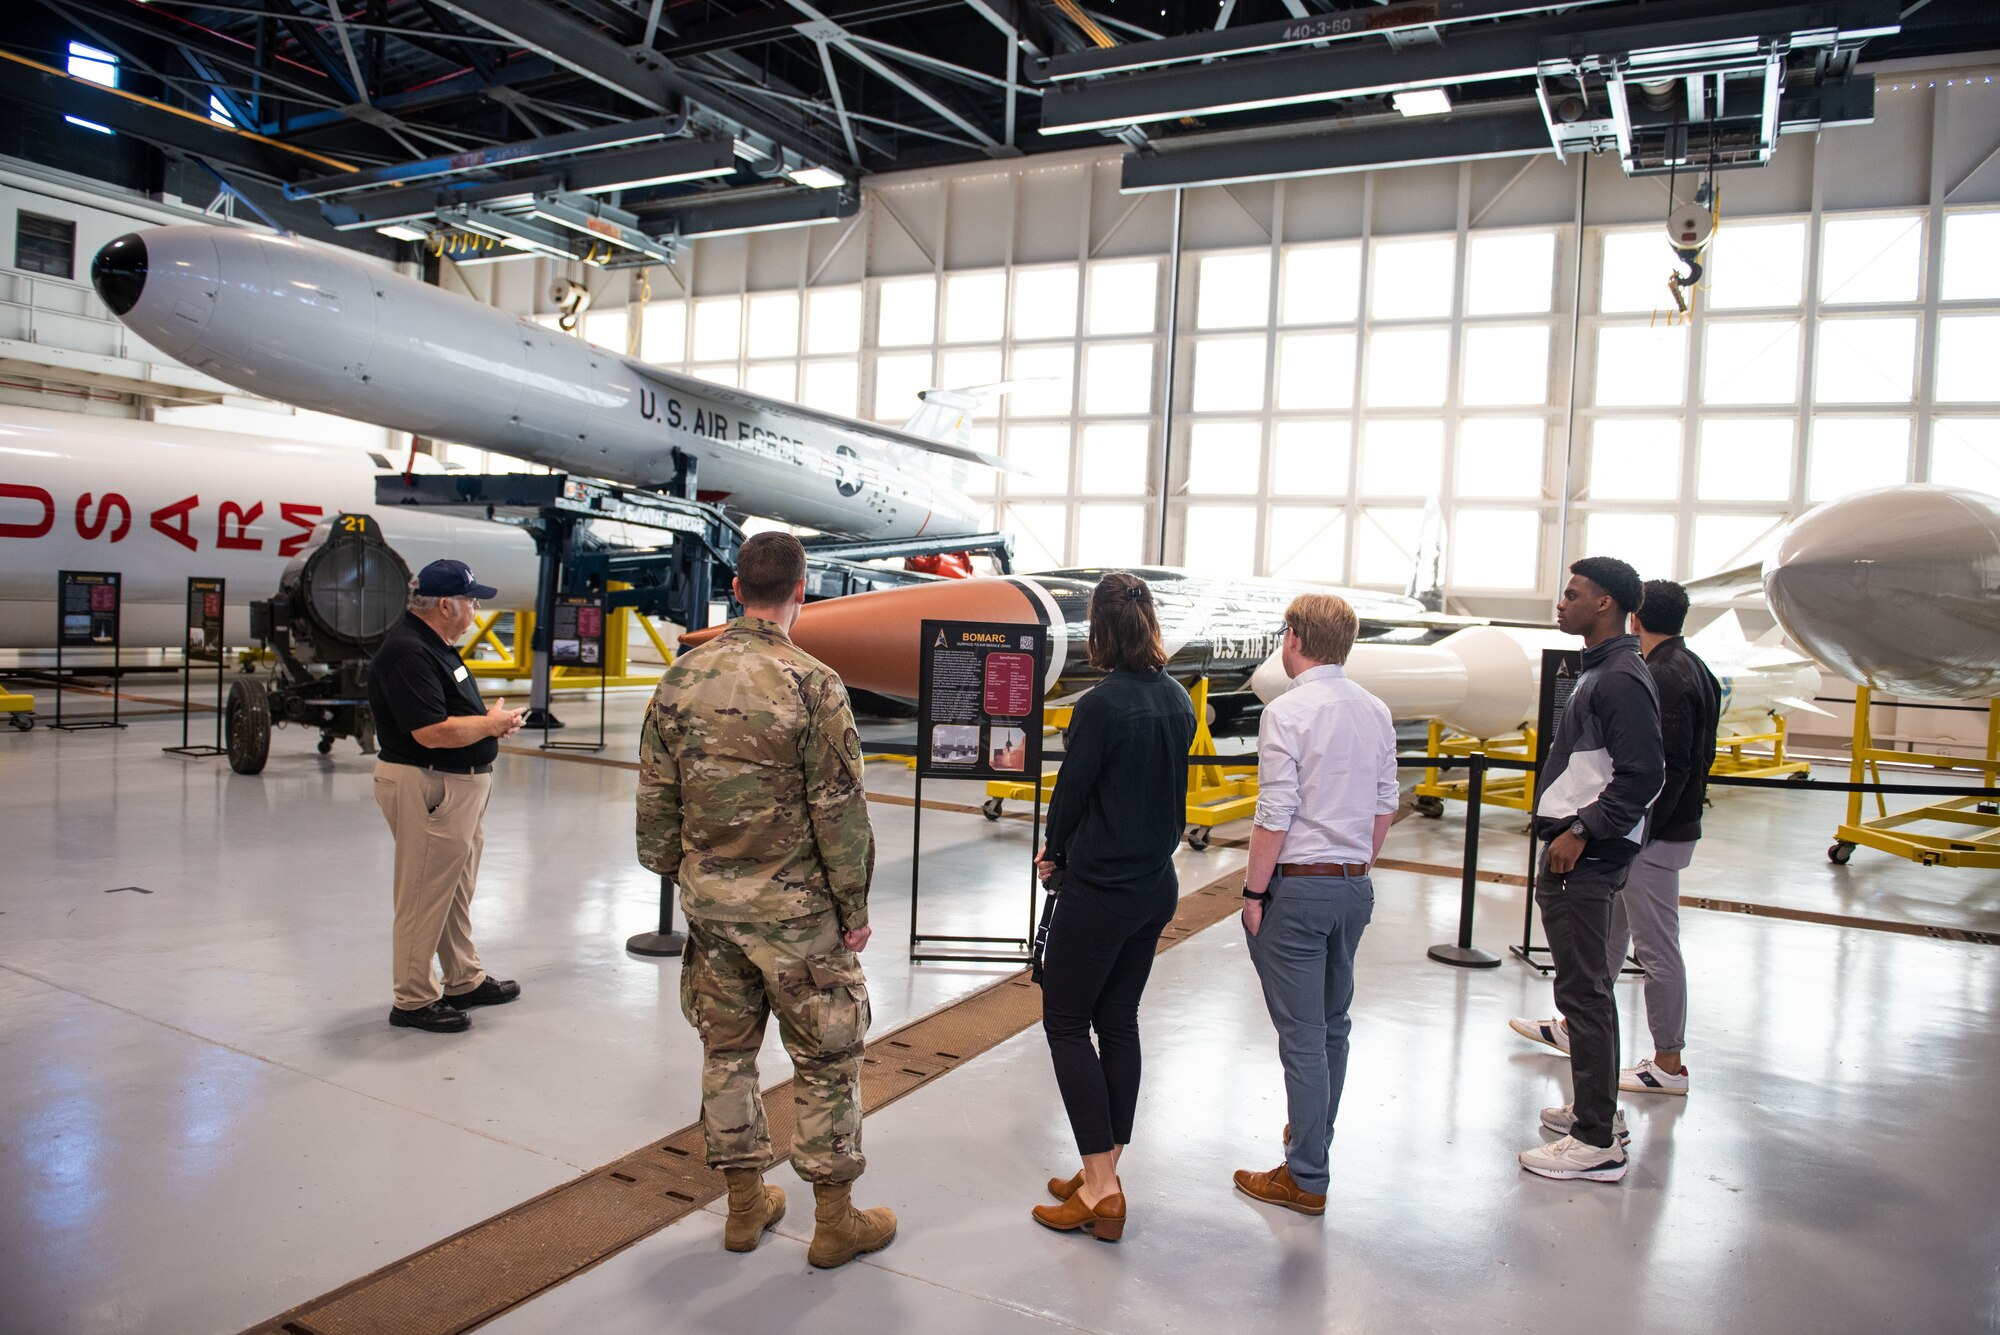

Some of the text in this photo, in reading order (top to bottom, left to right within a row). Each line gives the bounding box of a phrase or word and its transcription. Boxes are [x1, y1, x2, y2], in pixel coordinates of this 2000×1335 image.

[1283, 18, 1351, 41] 440-3-60
[693, 407, 728, 441] AIR
[738, 421, 804, 466] FORCE
[345, 516, 365, 532] 21
[962, 633, 1006, 642] BOMARC
[1241, 635, 1263, 659] AIR
